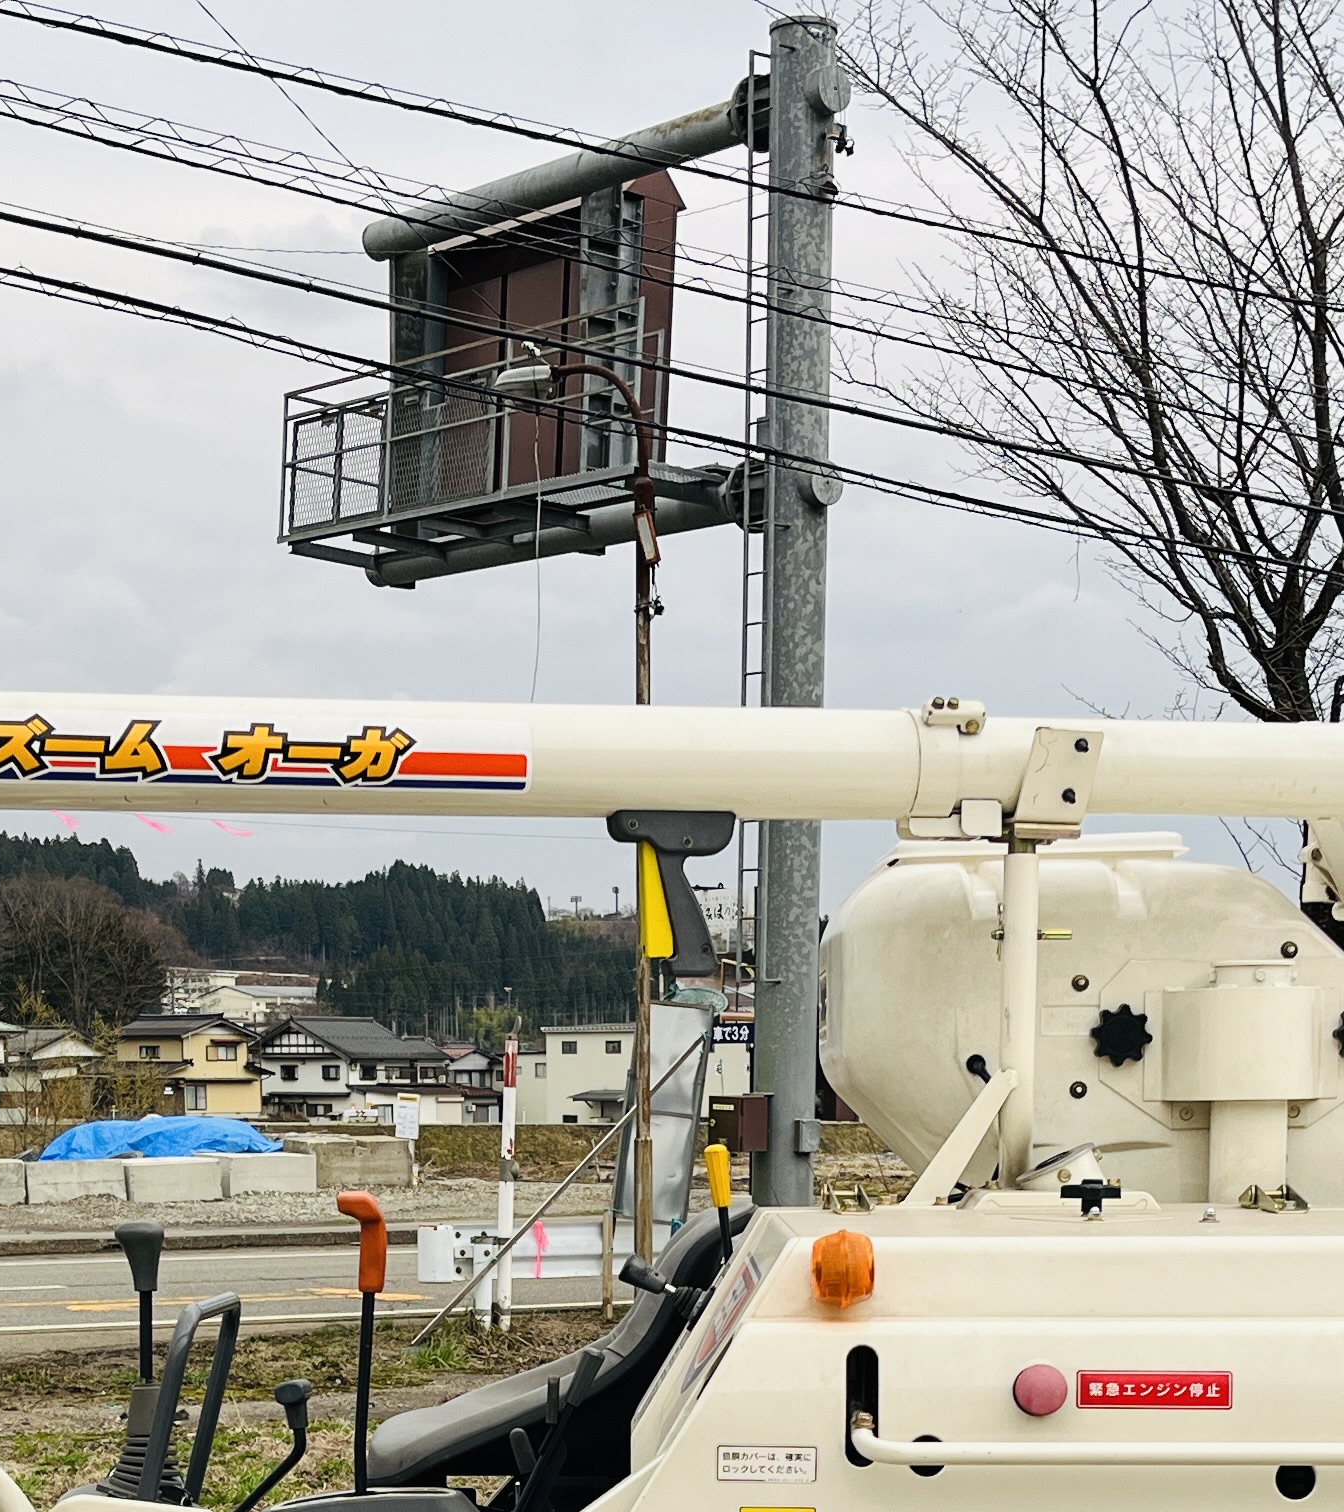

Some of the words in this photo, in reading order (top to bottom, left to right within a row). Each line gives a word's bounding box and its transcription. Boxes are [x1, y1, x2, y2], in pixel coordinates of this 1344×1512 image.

[218, 723, 415, 785] オーガ
[713, 1026, 750, 1041] 車で3分
[1088, 1382, 1222, 1398] 緊急エンジン停止
